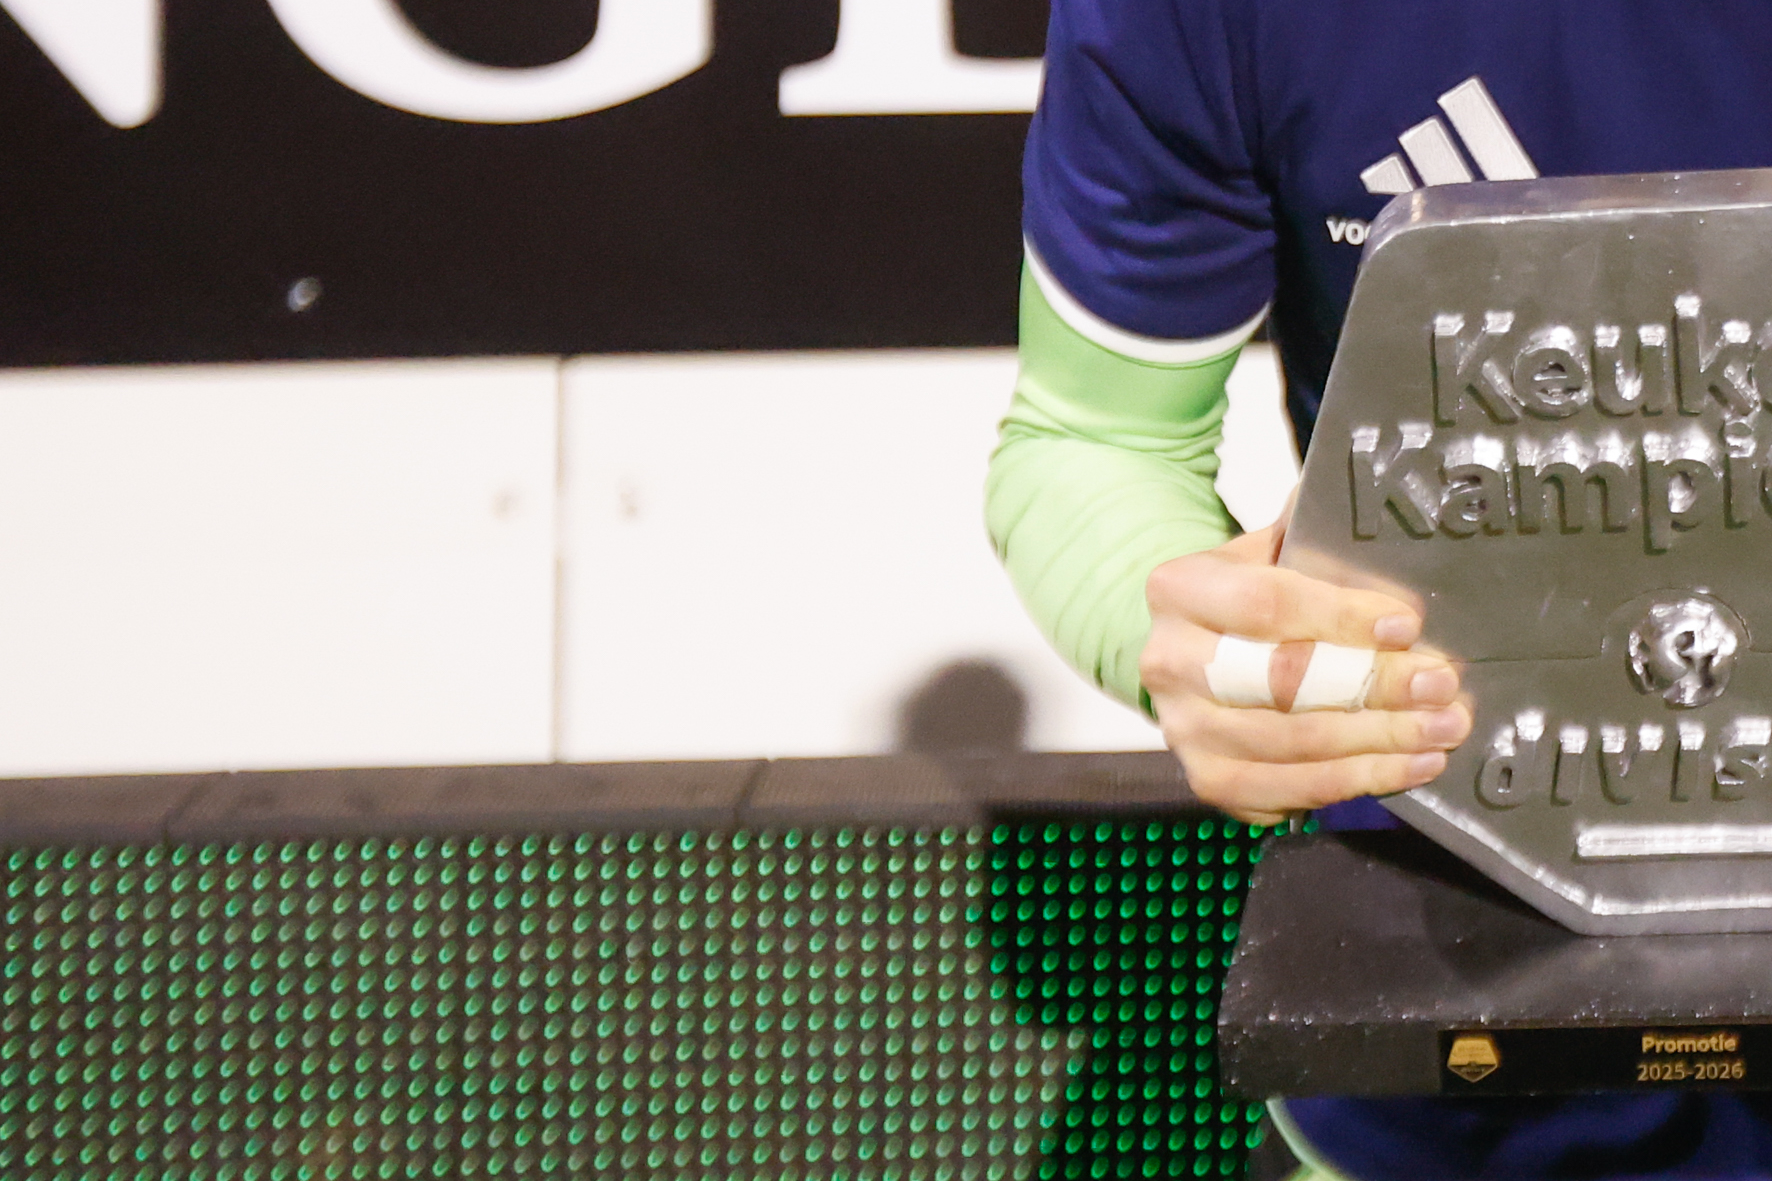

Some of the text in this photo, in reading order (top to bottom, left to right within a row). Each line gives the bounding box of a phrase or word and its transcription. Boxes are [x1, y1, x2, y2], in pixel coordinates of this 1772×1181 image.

[1325, 218, 1372, 246] VO
[1640, 1032, 1739, 1054] Promotie
[1637, 1061, 1745, 1082] 2025-2026
